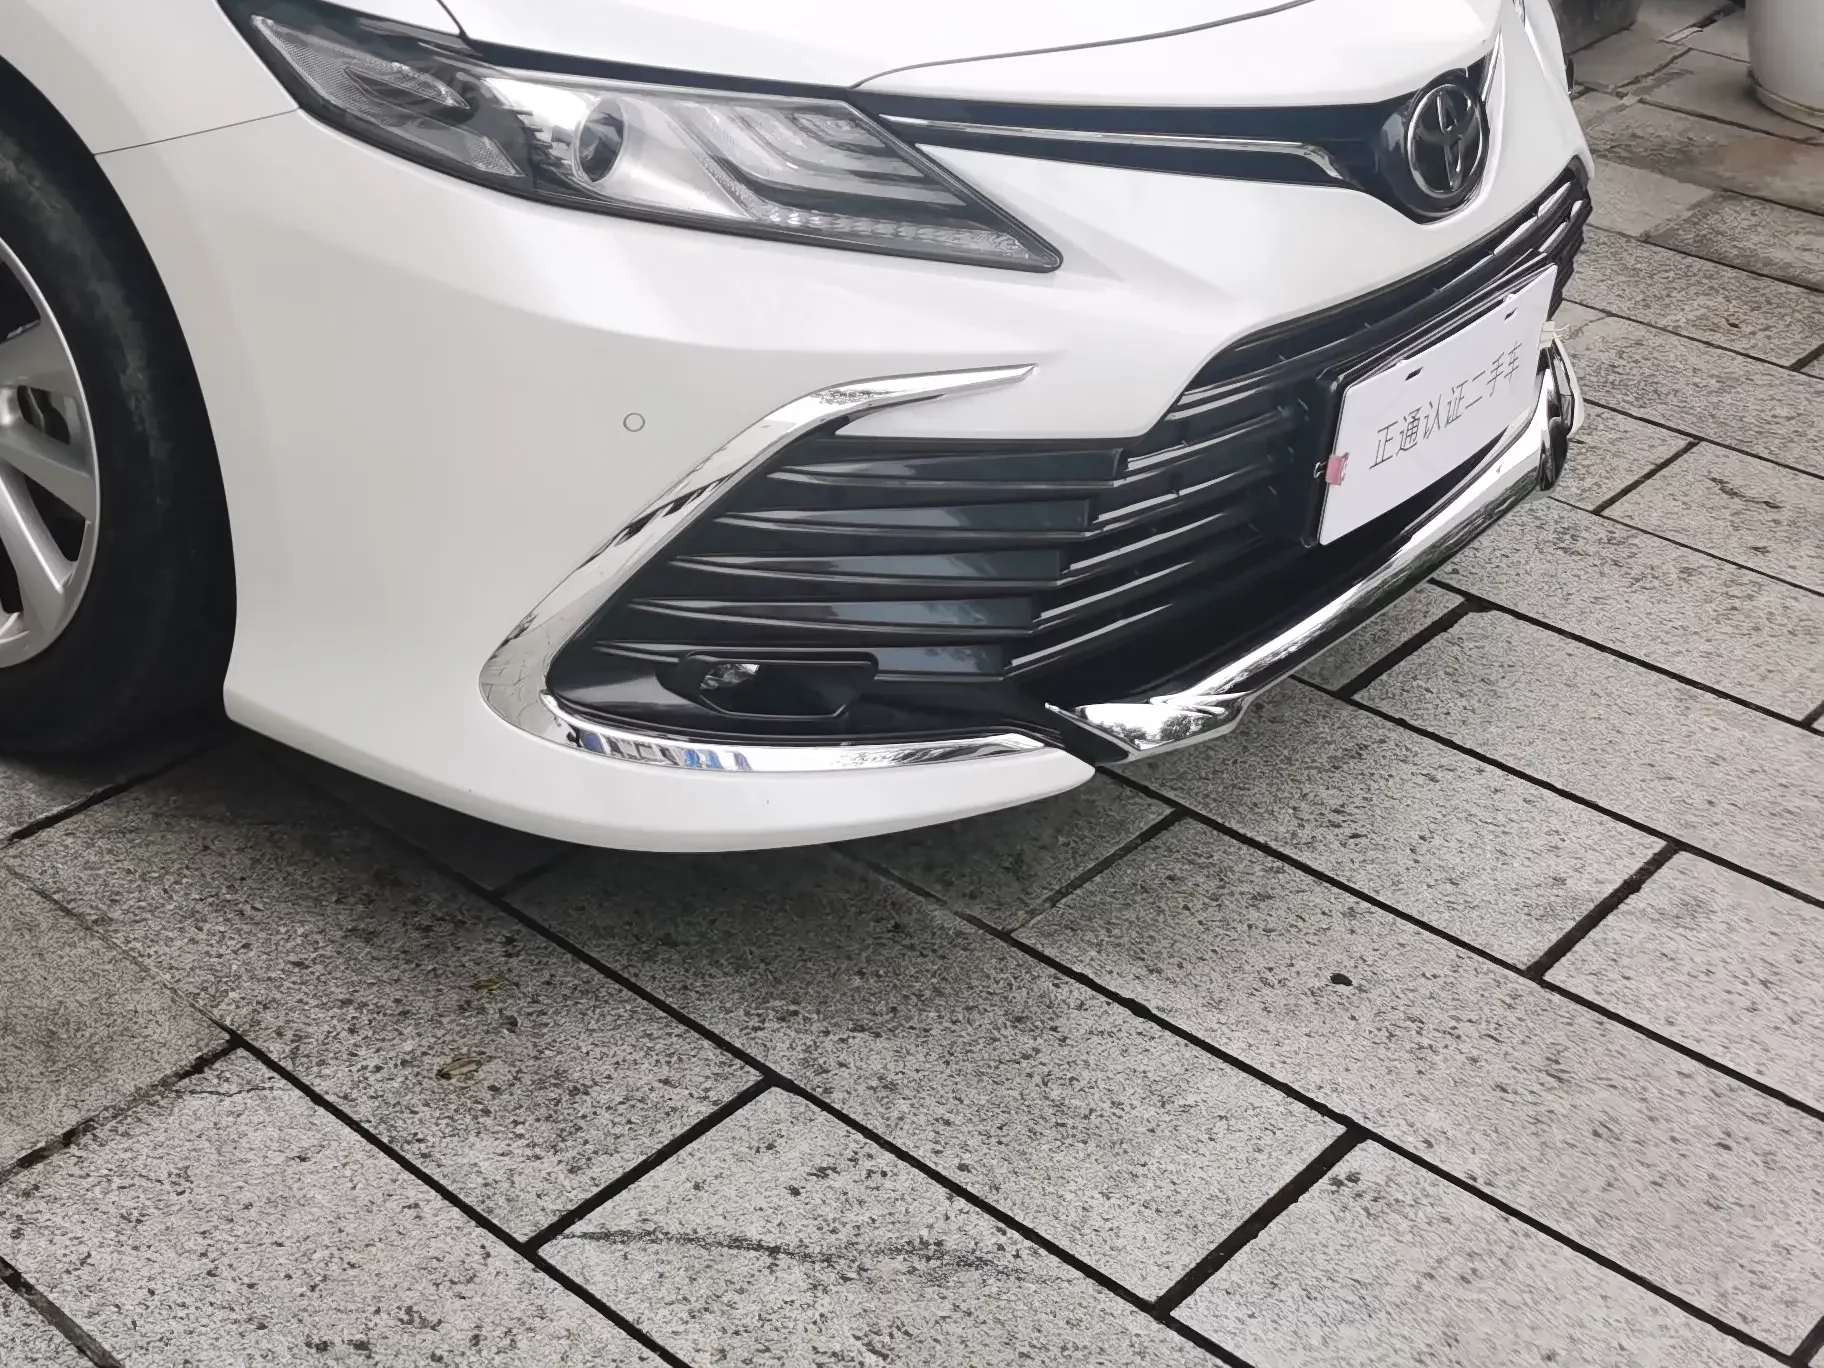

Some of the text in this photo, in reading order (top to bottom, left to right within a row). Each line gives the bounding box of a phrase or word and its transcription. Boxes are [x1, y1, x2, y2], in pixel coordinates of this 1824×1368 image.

[1369, 340, 1523, 470] 正通认证二手车
